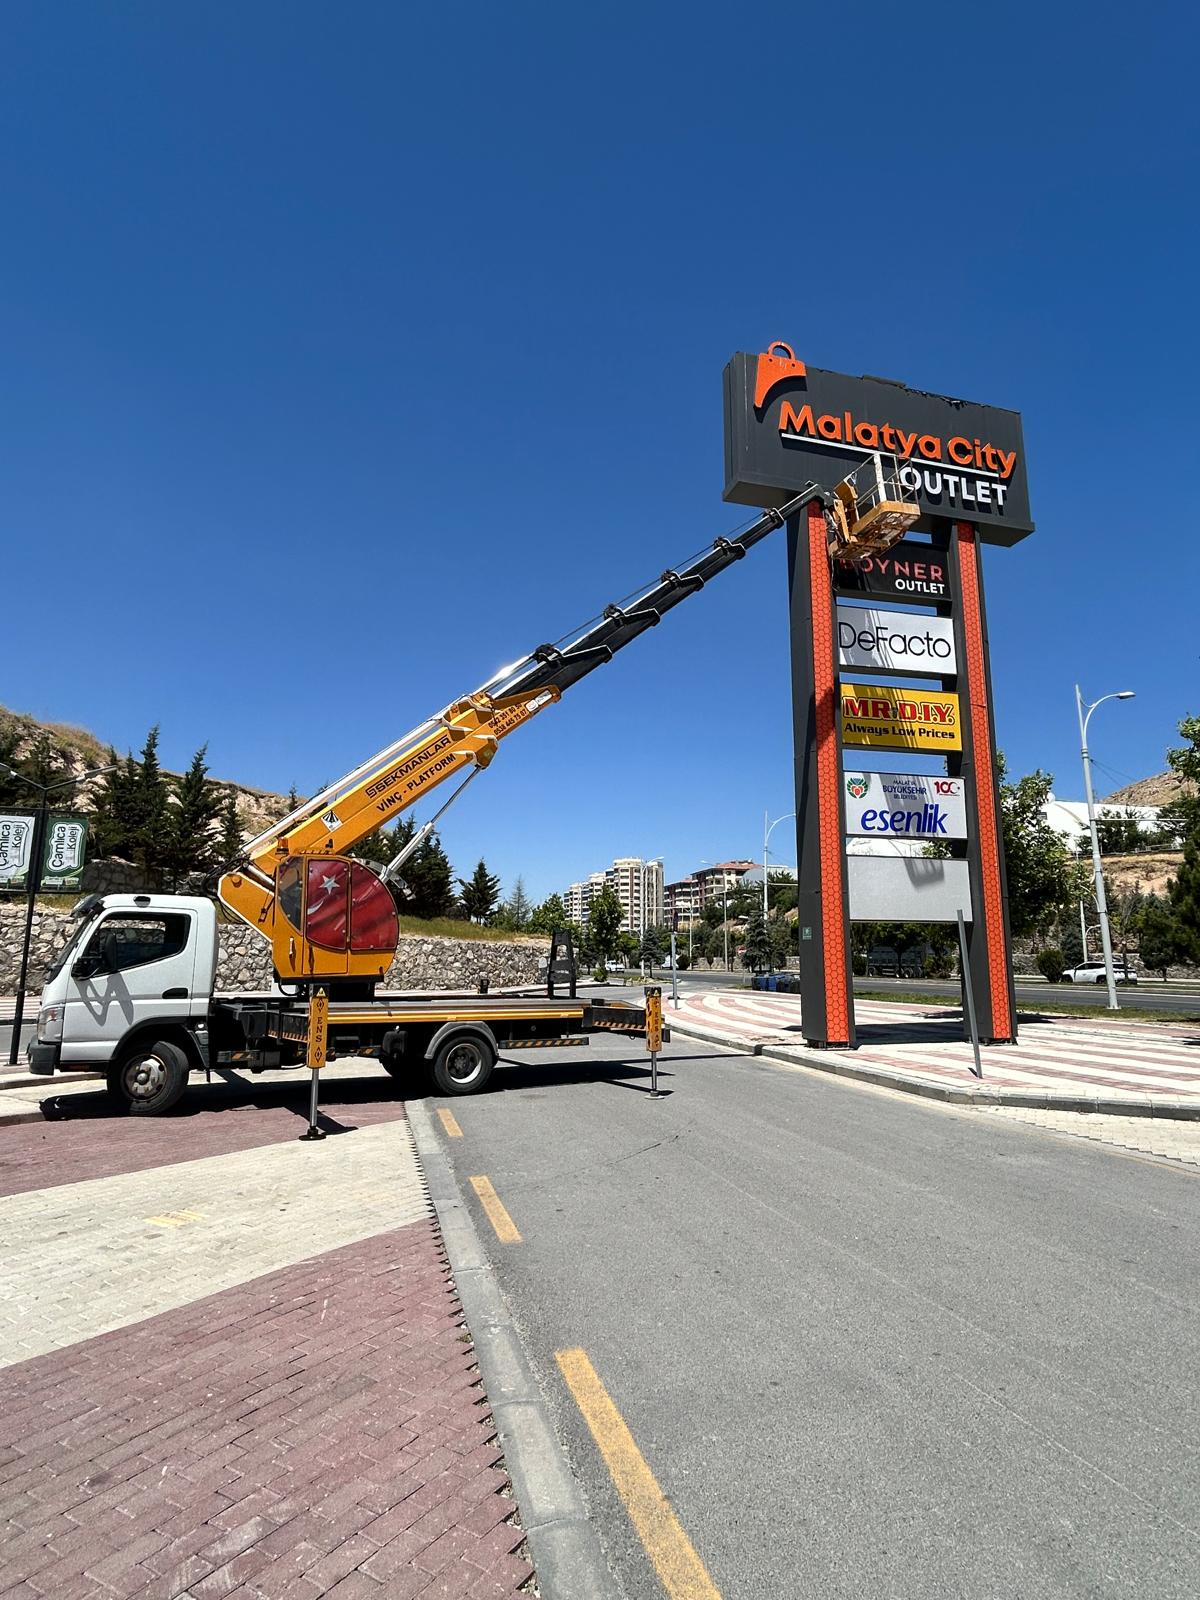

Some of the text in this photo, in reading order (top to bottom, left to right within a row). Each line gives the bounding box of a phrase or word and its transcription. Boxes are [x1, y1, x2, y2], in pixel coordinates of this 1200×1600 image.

[778, 400, 1017, 478] Malatya City
[900, 466, 1007, 506] OUTLET
[840, 557, 943, 581] OYNER
[895, 579, 945, 594] OUTLET
[838, 621, 951, 658] DeFacto
[845, 723, 955, 739] Always Low Prices
[376, 791, 402, 812] VİNÇ
[406, 753, 456, 790] PLATFORM
[860, 803, 948, 834] esenlik
[12, 824, 24, 848] Koleji
[67, 826, 79, 850] Koleji
